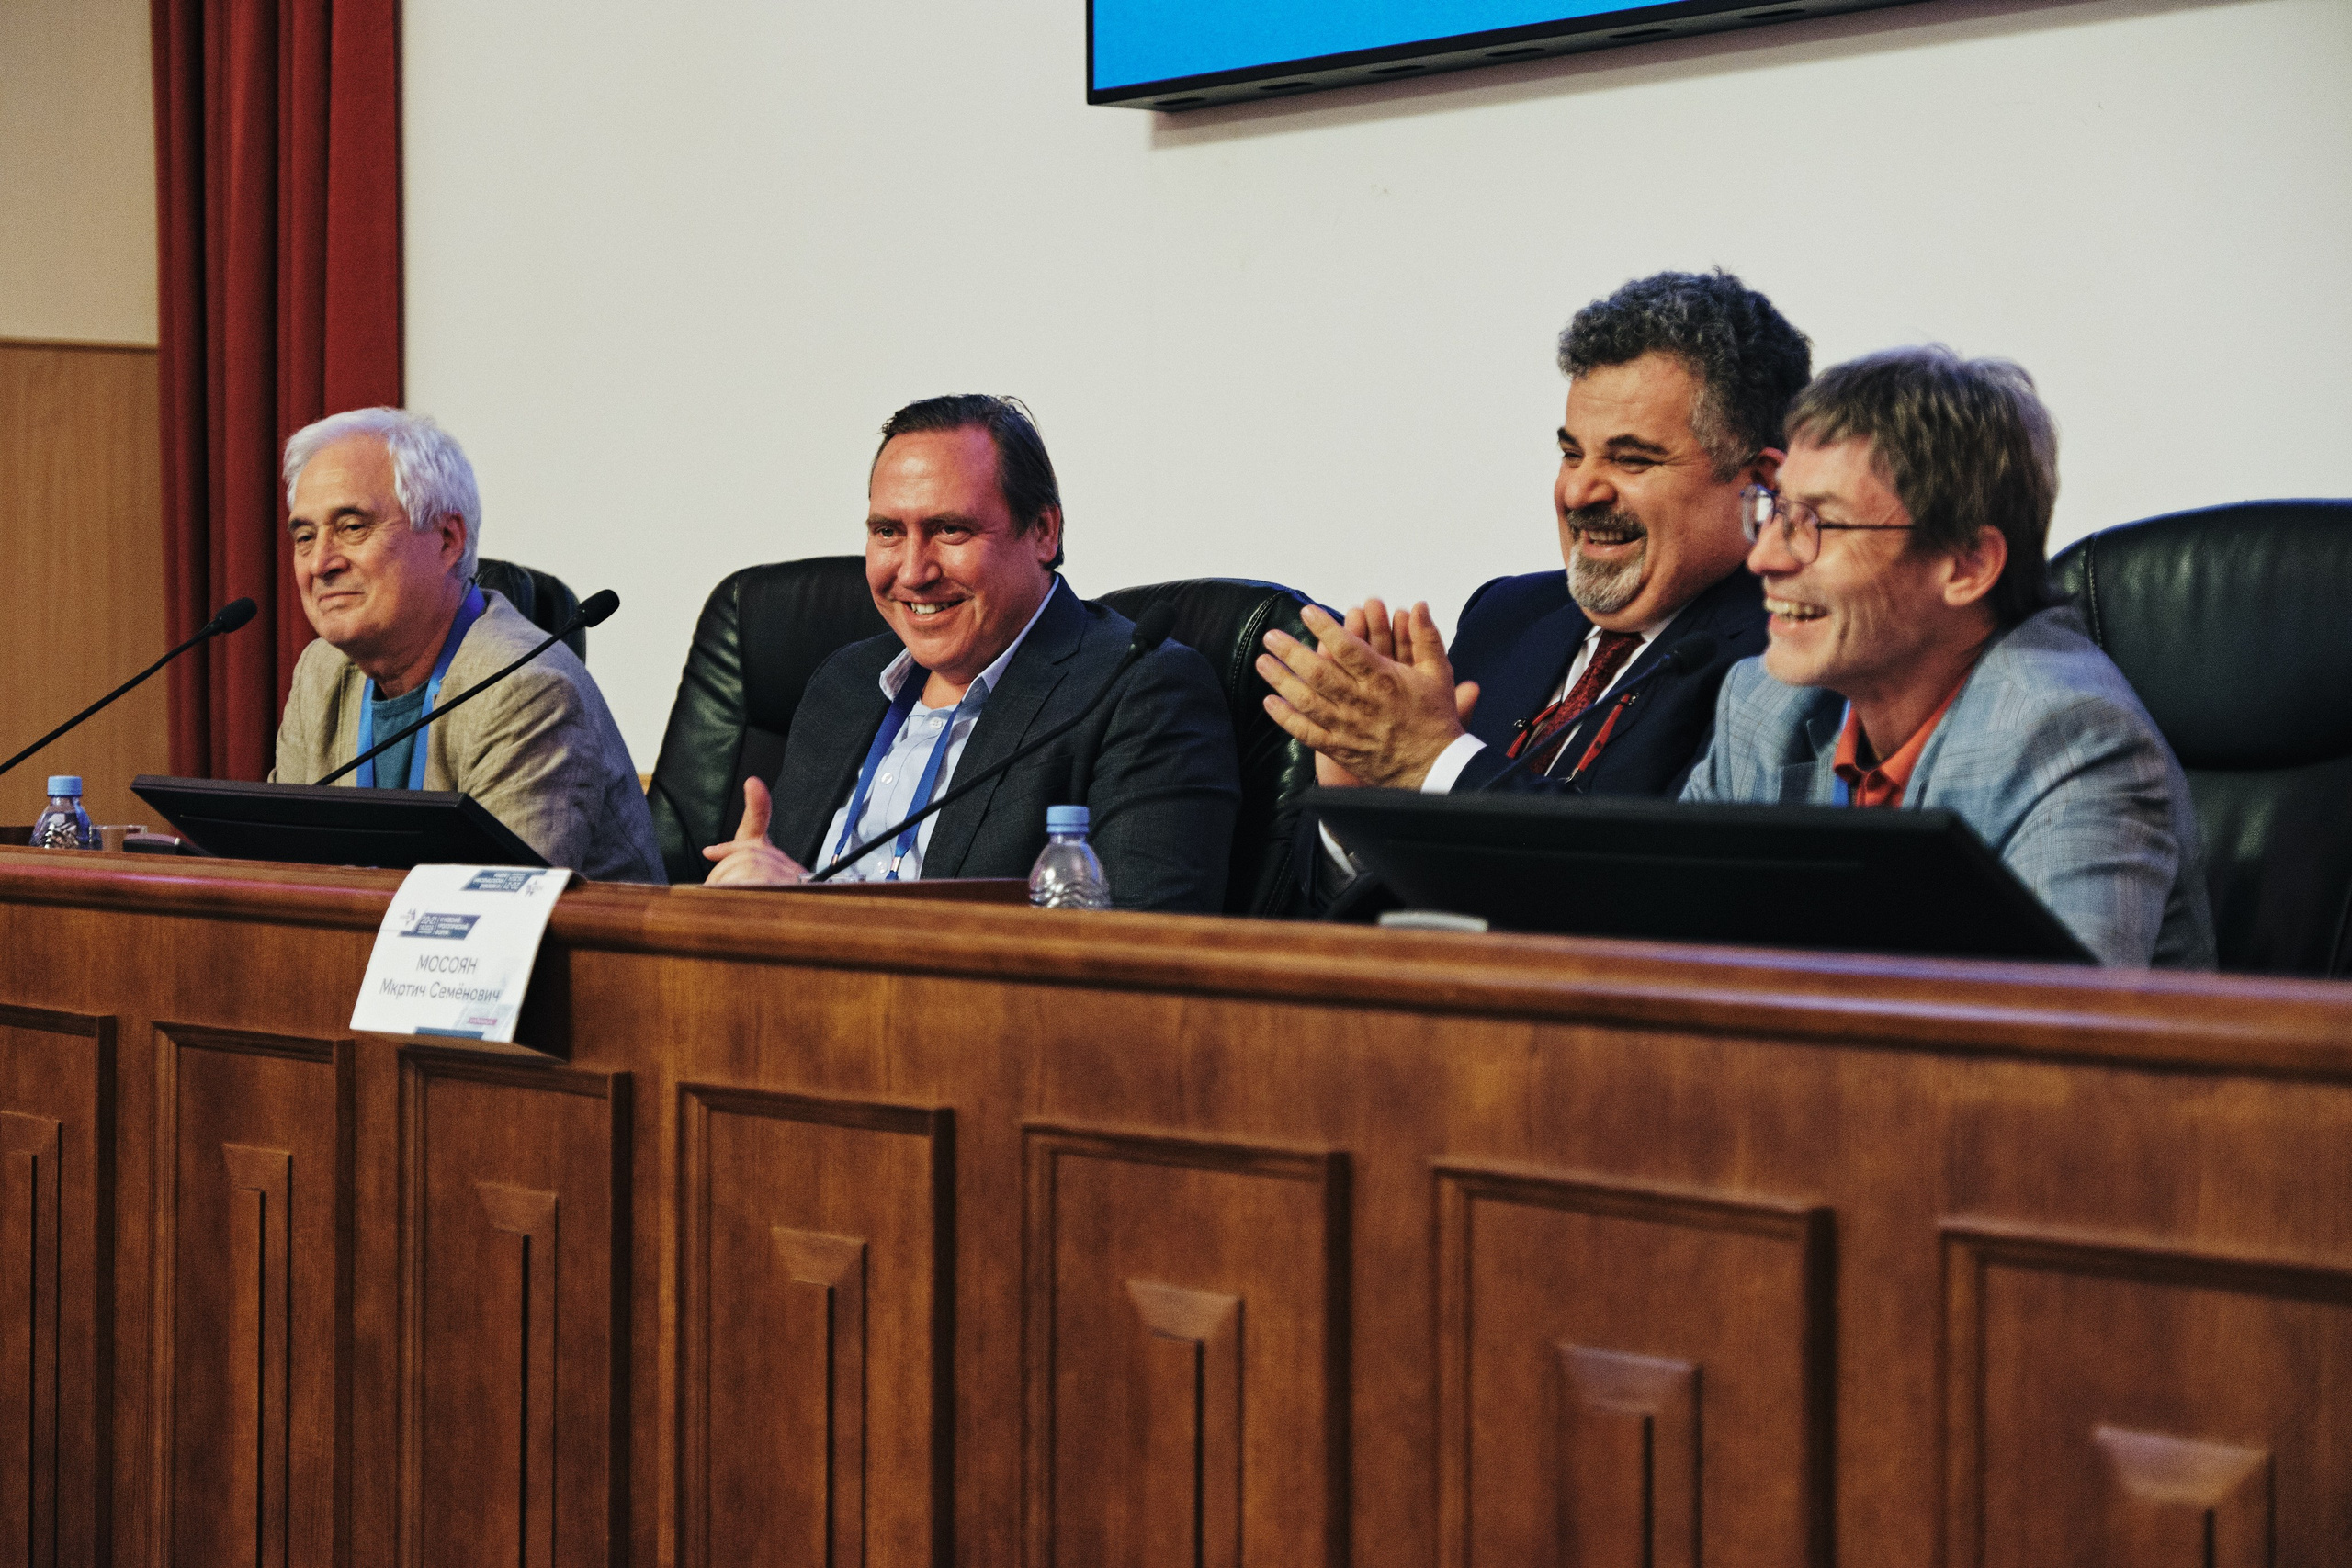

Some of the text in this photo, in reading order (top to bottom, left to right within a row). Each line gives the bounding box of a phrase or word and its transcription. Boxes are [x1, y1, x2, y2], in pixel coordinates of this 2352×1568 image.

[415, 954, 478, 975] МОСОЯН
[379, 978, 501, 1002] Мкртич Семёнович
